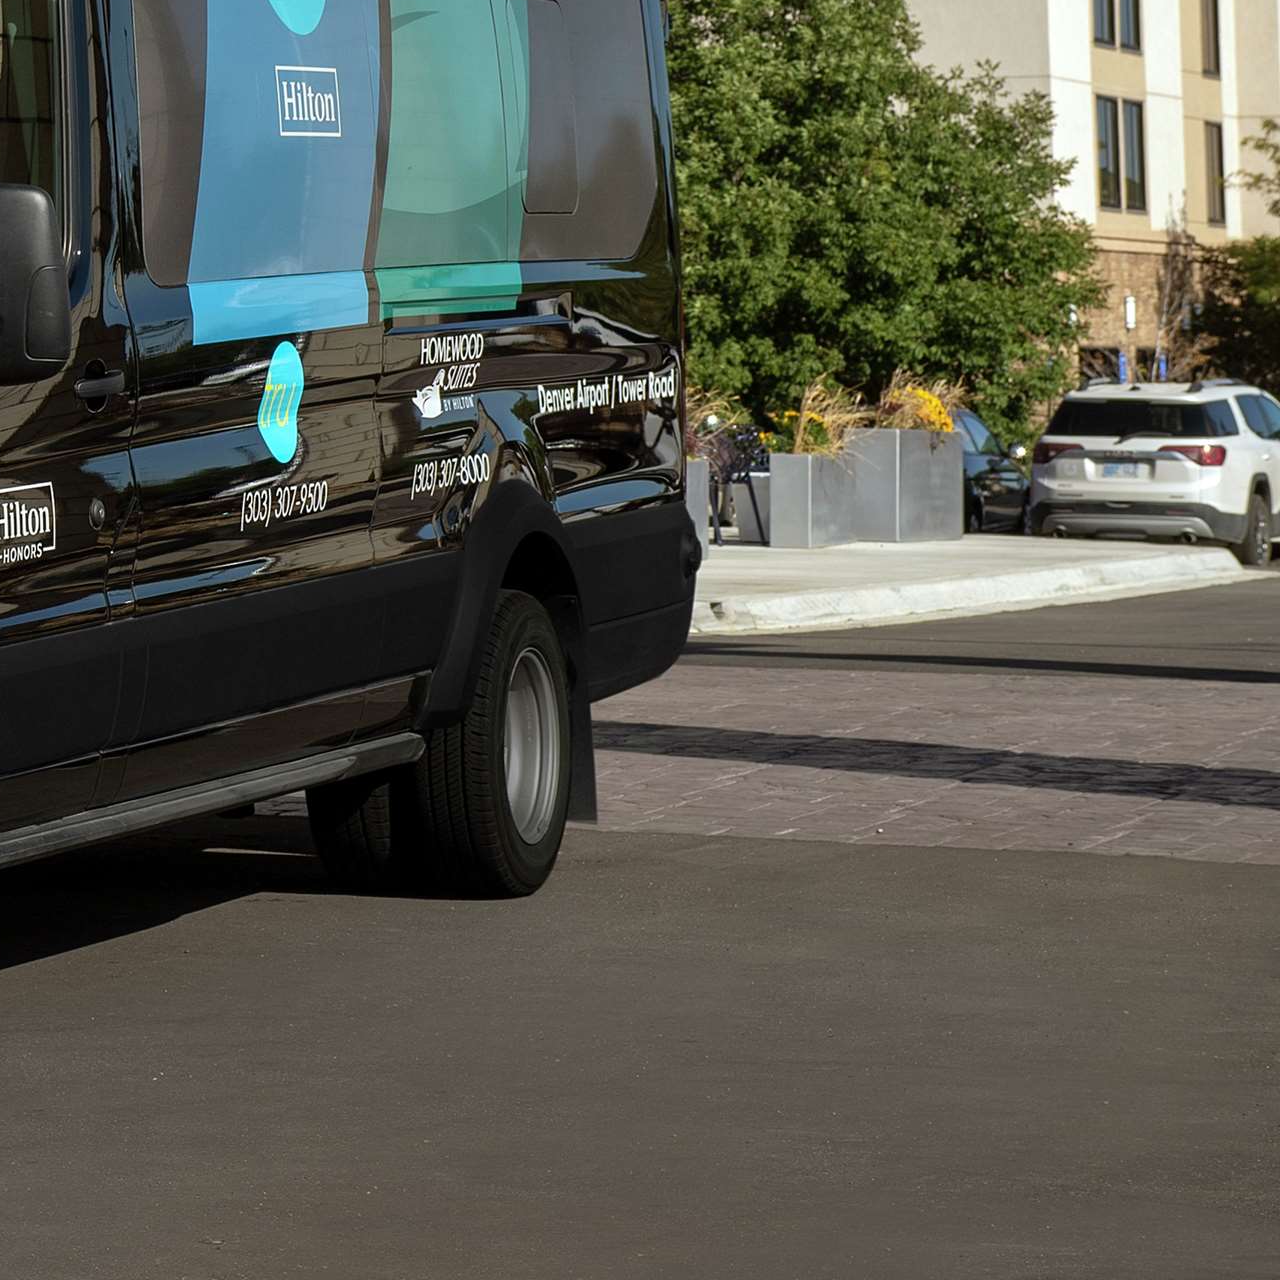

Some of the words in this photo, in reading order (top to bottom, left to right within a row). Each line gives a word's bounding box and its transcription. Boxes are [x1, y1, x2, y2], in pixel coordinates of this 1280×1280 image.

[281, 80, 336, 122] Hilton
[420, 333, 484, 366] HOMEWOOD
[443, 362, 481, 391] SUITES
[537, 384, 575, 414] Denver
[576, 376, 609, 415] Airport
[617, 375, 647, 403] Tower
[648, 368, 675, 400] Road
[260, 370, 297, 428] tru
[410, 460, 438, 500] (303)
[438, 453, 490, 488] 307-8000
[240, 489, 272, 531] (303)
[274, 480, 328, 518] 307-9500
[2, 542, 43, 563] HONORS
